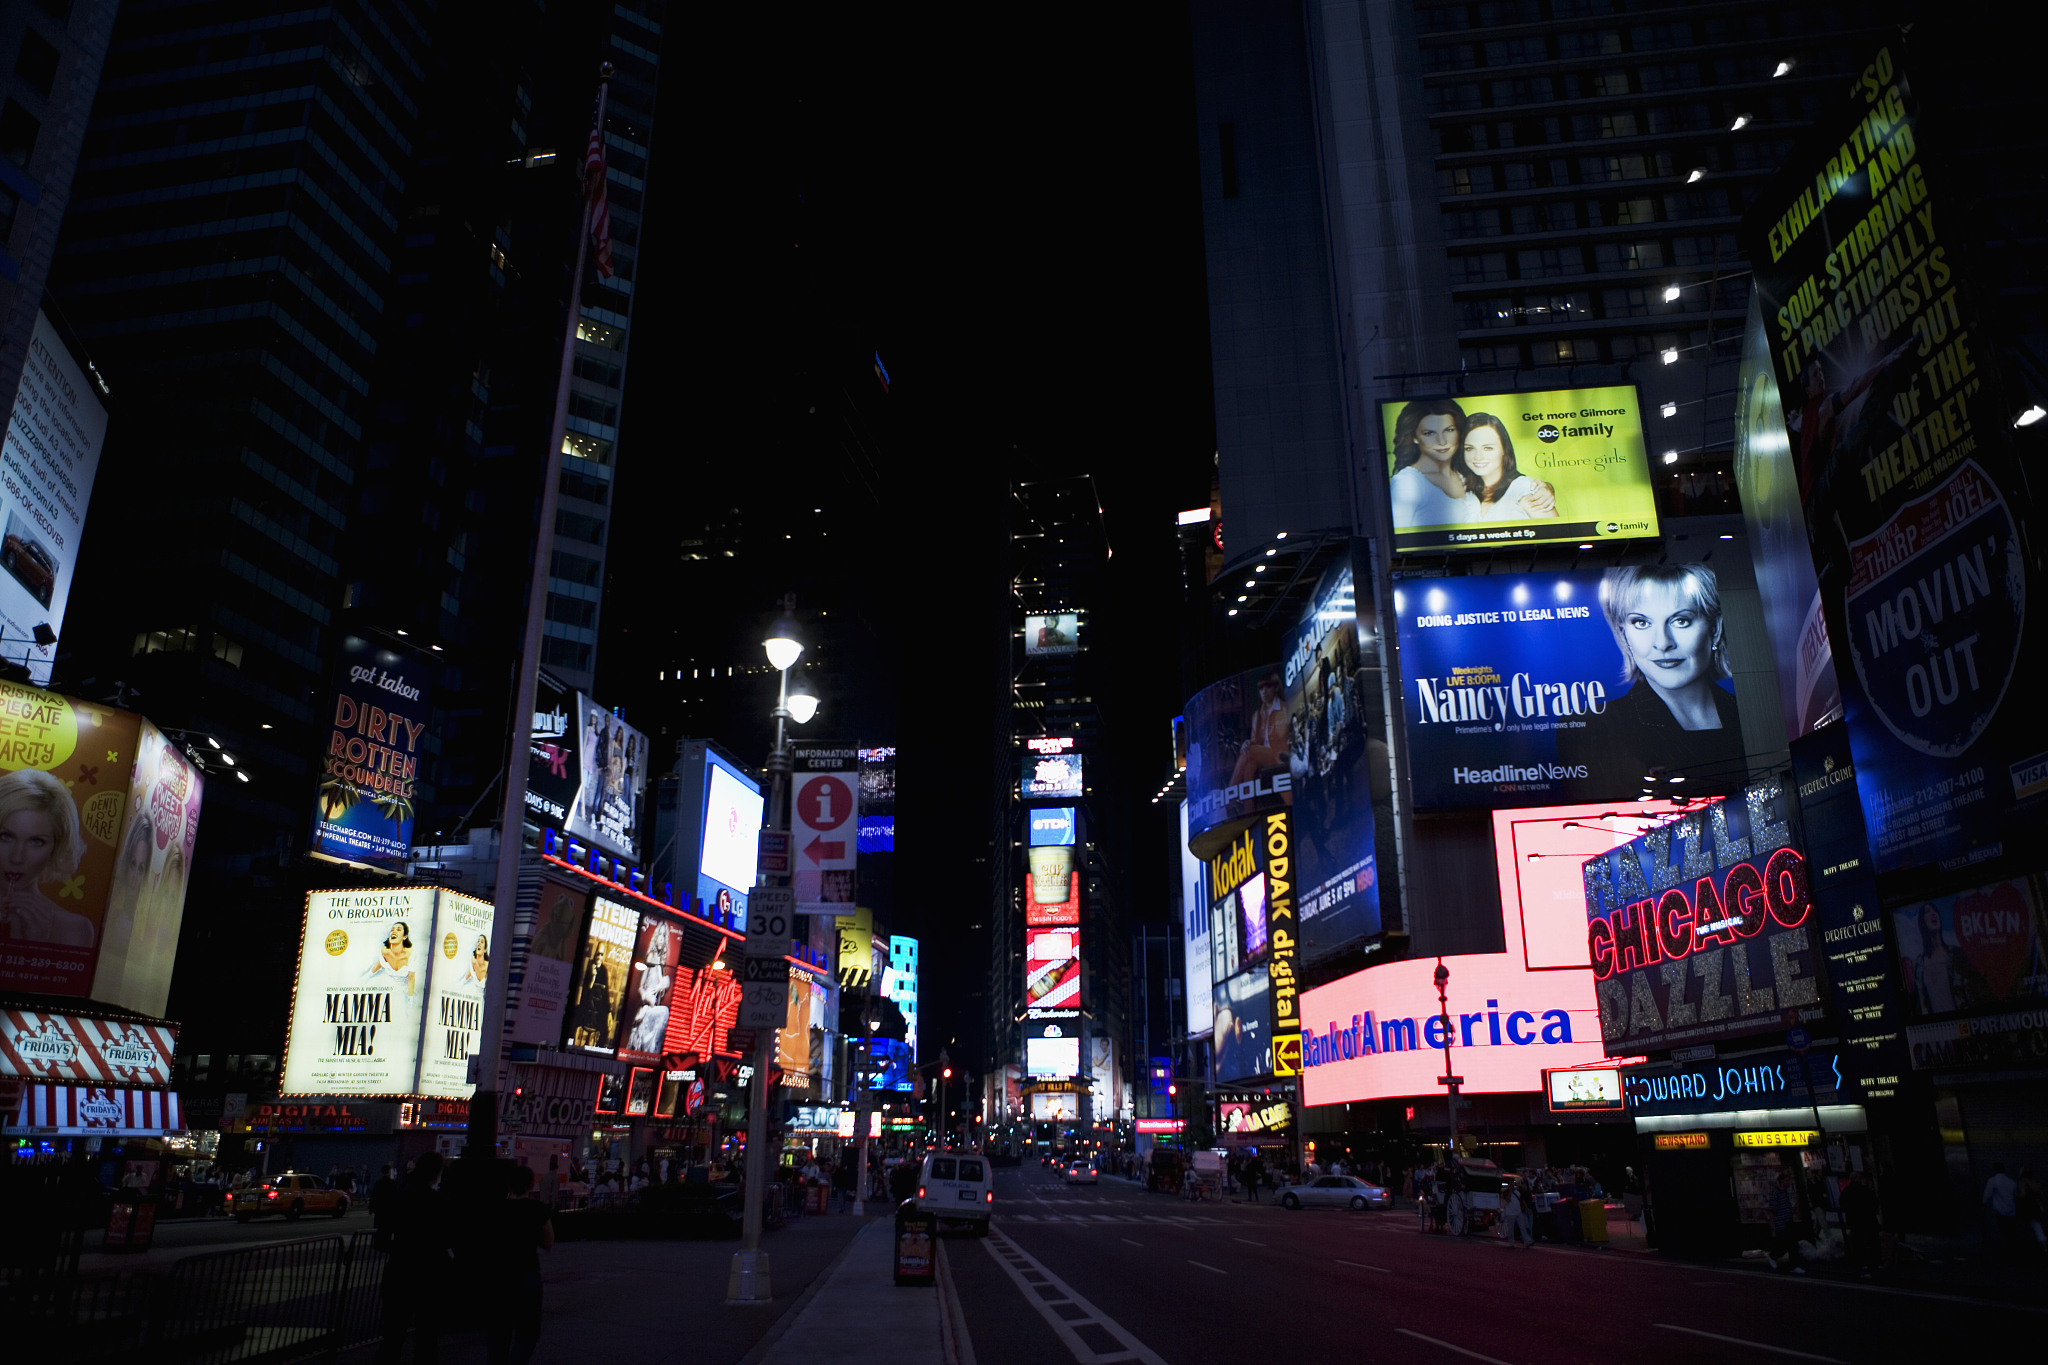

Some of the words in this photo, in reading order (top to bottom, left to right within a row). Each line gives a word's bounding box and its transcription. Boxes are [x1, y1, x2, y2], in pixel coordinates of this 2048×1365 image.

[1768, 84, 1906, 263] EXHILARATING
[1868, 123, 1916, 200] AND
[1777, 163, 1929, 342] SOUL-STIRRING
[1782, 338, 1802, 382] IT
[1801, 201, 1937, 358] PRACTICALLY
[1859, 246, 1951, 354] BURSTS
[1914, 286, 1962, 357] OUT
[32, 337, 79, 409] ATTENTION:
[1923, 332, 1977, 391] THE
[26, 352, 44, 383] have
[44, 382, 57, 402] any
[57, 397, 91, 449] information
[1522, 412, 1544, 422] Get
[1546, 411, 1577, 420] more
[1580, 406, 1626, 418] Gilmore
[1537, 428, 1560, 439] abc
[1561, 423, 1614, 439] family
[1534, 451, 1591, 469] Gilmore
[1593, 448, 1627, 472] girls
[31, 459, 47, 483] Audi
[48, 481, 56, 493] of
[55, 489, 80, 524] America
[1949, 470, 1973, 496] BILLY
[1944, 479, 1991, 531] JOEL
[1448, 533, 1455, 542] 5
[1456, 532, 1478, 543] days
[1479, 533, 1486, 541] a
[1486, 530, 1511, 540] week
[1512, 529, 1522, 539] at
[1523, 530, 1536, 541] 5p
[1875, 522, 1900, 547] TWYLA
[1864, 524, 1918, 581] THARP
[1417, 615, 1453, 628] DOING
[1454, 612, 1500, 626] JUSTICE
[1501, 611, 1517, 623] TO
[1518, 609, 1555, 622] LEGAL
[1556, 606, 1590, 620] NEWS
[350, 664, 377, 685] get
[378, 669, 421, 702] taken
[1446, 675, 1466, 687] LIVE
[1466, 673, 1501, 686] 8:00PM
[1452, 665, 1493, 676] Weeknights
[1905, 633, 1981, 719] OUT
[334, 693, 426, 753] DIRTY
[1455, 724, 1493, 735] Primetime's
[1506, 723, 1521, 734] only
[1521, 722, 1533, 731] live
[1533, 721, 1550, 732] legal
[1550, 721, 1568, 730] news
[1568, 720, 1587, 730] show
[330, 729, 418, 782] ROTTEN
[795, 748, 857, 759] INFORMATION
[808, 758, 844, 768] CENTER
[326, 757, 415, 799] SCOUNDRELS
[1499, 784, 1517, 792] CNN
[1517, 782, 1550, 791] NETWORK
[1800, 778, 1828, 798] PERFECT
[1829, 764, 1854, 788] CRIME
[1916, 766, 1985, 805] 212-307-4100
[2019, 764, 2048, 787] VISA
[91, 797, 118, 818] DENIS
[1920, 801, 1953, 821] RODGERS
[1953, 788, 1985, 808] THEATRE
[85, 812, 114, 840] HARE
[320, 820, 372, 841] TELECHARGE.COM
[1584, 775, 1792, 917] RAZZLE
[1941, 856, 1967, 870] VISTA
[1968, 846, 1999, 862] MEDIA
[416, 868, 437, 876] VISTA
[438, 870, 461, 879] MEDIA
[1212, 829, 1257, 901] Kodak
[1266, 811, 1293, 922] KODAK
[354, 896, 386, 907] MOST
[389, 895, 410, 905] FUN
[752, 892, 790, 901] SPEED
[755, 904, 784, 913] LIMIT
[328, 909, 344, 919] ON
[593, 896, 640, 931] STEVIE
[751, 915, 786, 936] 30
[1588, 847, 1812, 981] CHICAGO
[1961, 912, 2020, 937] BKLYN
[589, 918, 636, 948] WONDER
[1825, 926, 1856, 943] PERFECT
[1857, 919, 1882, 937] CRIME
[758, 970, 786, 981] LANE
[761, 960, 786, 970] BIKE
[1268, 929, 1300, 1028] digital
[1598, 927, 1821, 1044] DAZZLE
[322, 993, 392, 1023] MAMMA
[438, 996, 480, 1031] MAMMA
[751, 1012, 777, 1022] ONLY
[1798, 1006, 1824, 1025] Sprint
[23, 1041, 71, 1055] FRIDAY'S
[332, 1024, 376, 1056] MIA!
[444, 1029, 471, 1061] MIA!
[109, 1049, 150, 1061] FRIDAY'S
[86, 1105, 117, 1115] FRIDAY'S
[259, 1104, 353, 1117] DIGITAL
[508, 1097, 542, 1123] BAR
[549, 1097, 593, 1126] CODE
[1245, 1111, 1263, 1132] LA
[1261, 1103, 1292, 1126] CAGE
[1656, 1134, 1706, 1147] NEWSSTAND
